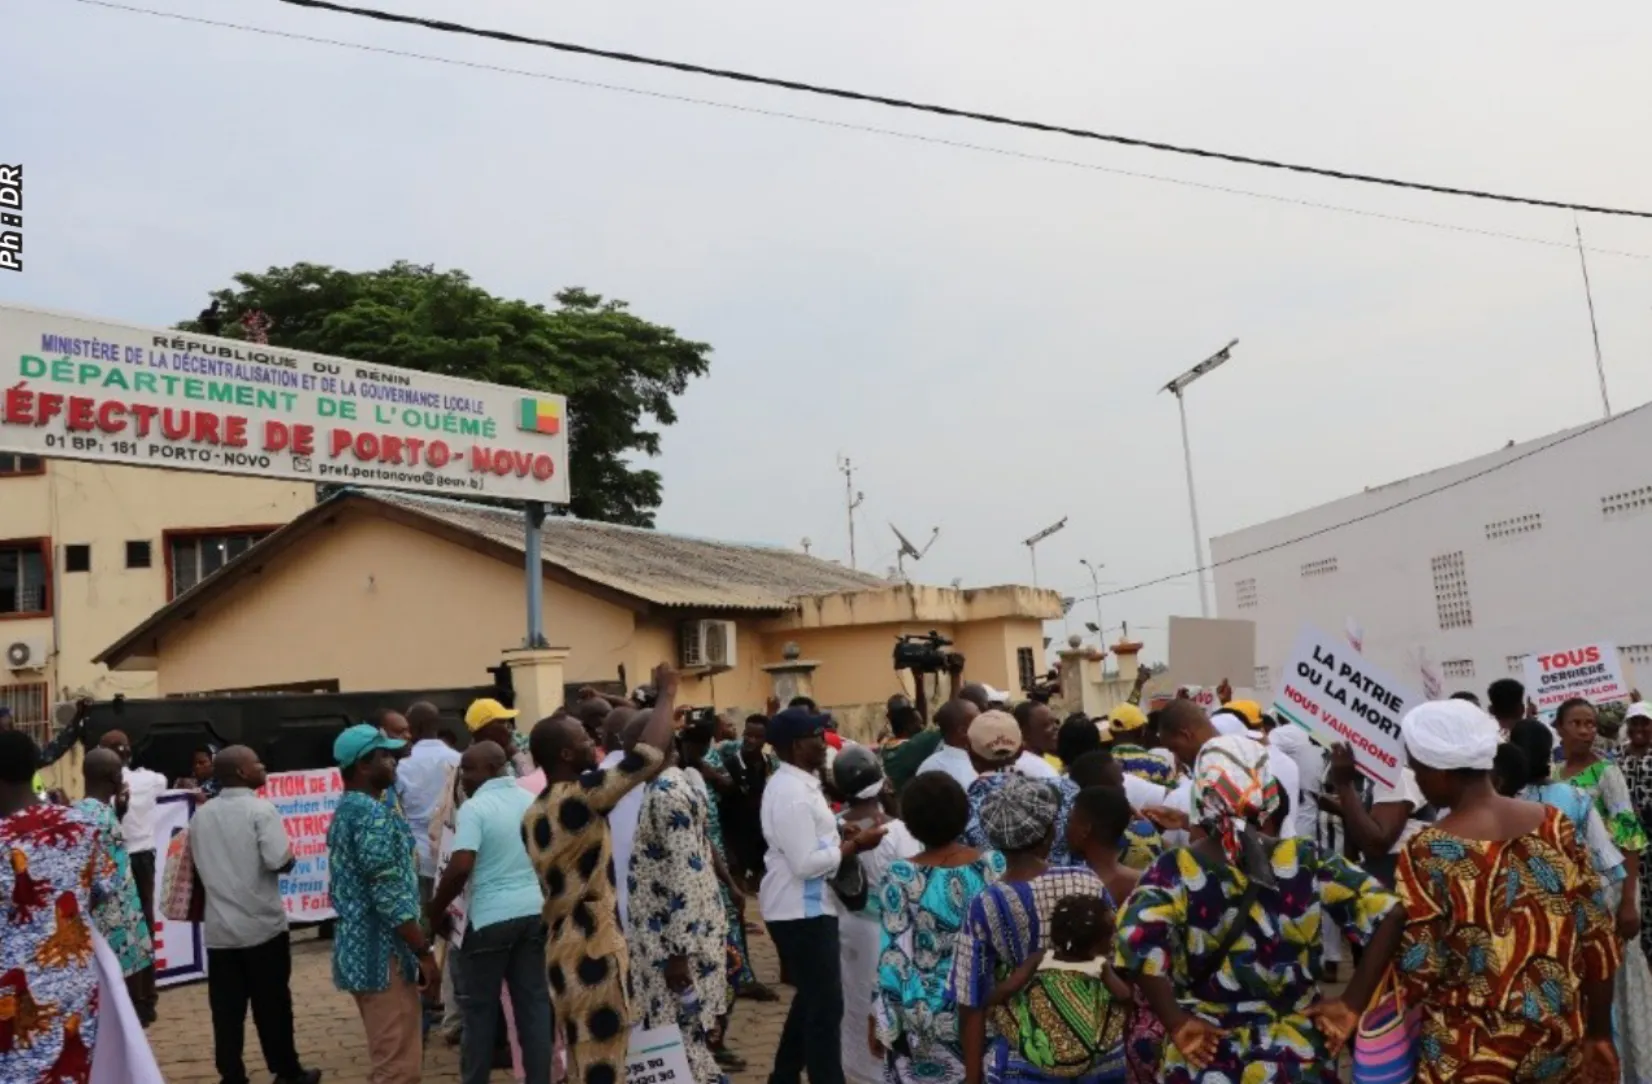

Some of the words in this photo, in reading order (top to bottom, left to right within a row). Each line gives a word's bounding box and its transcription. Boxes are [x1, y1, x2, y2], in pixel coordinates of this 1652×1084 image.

[41, 333, 120, 361] MINISTÈRE
[125, 346, 144, 365] DE
[150, 351, 169, 369] LA
[173, 351, 298, 389] DÉCENTRALISATION
[302, 374, 317, 391] ET
[321, 377, 337, 394] DE
[341, 381, 357, 397] LA
[361, 383, 440, 409] GOUVERNANCE
[444, 395, 484, 415] LOCALE
[152, 335, 298, 369] RÉPUBLIQUE
[313, 361, 341, 375] DU
[355, 368, 411, 386] BÉNIN
[20, 354, 298, 413] DÉPARTEMENT
[318, 396, 357, 420] DE
[375, 404, 497, 439] L'OUÉMÉ
[45, 434, 66, 448] 01
[263, 420, 315, 456] DE
[330, 428, 554, 481] PORTO-NOVO
[1313, 645, 1335, 671] LA
[1339, 662, 1404, 714] PATRIE
[1537, 646, 1600, 671] TOUS
[1297, 662, 1323, 686] OU
[1324, 680, 1347, 706] LA
[1351, 697, 1402, 740] MORT
[1583, 683, 1618, 696] TALON
[1284, 684, 1320, 715] NOUS
[1322, 709, 1398, 769] VAINCRONS
[310, 776, 326, 794] DE
